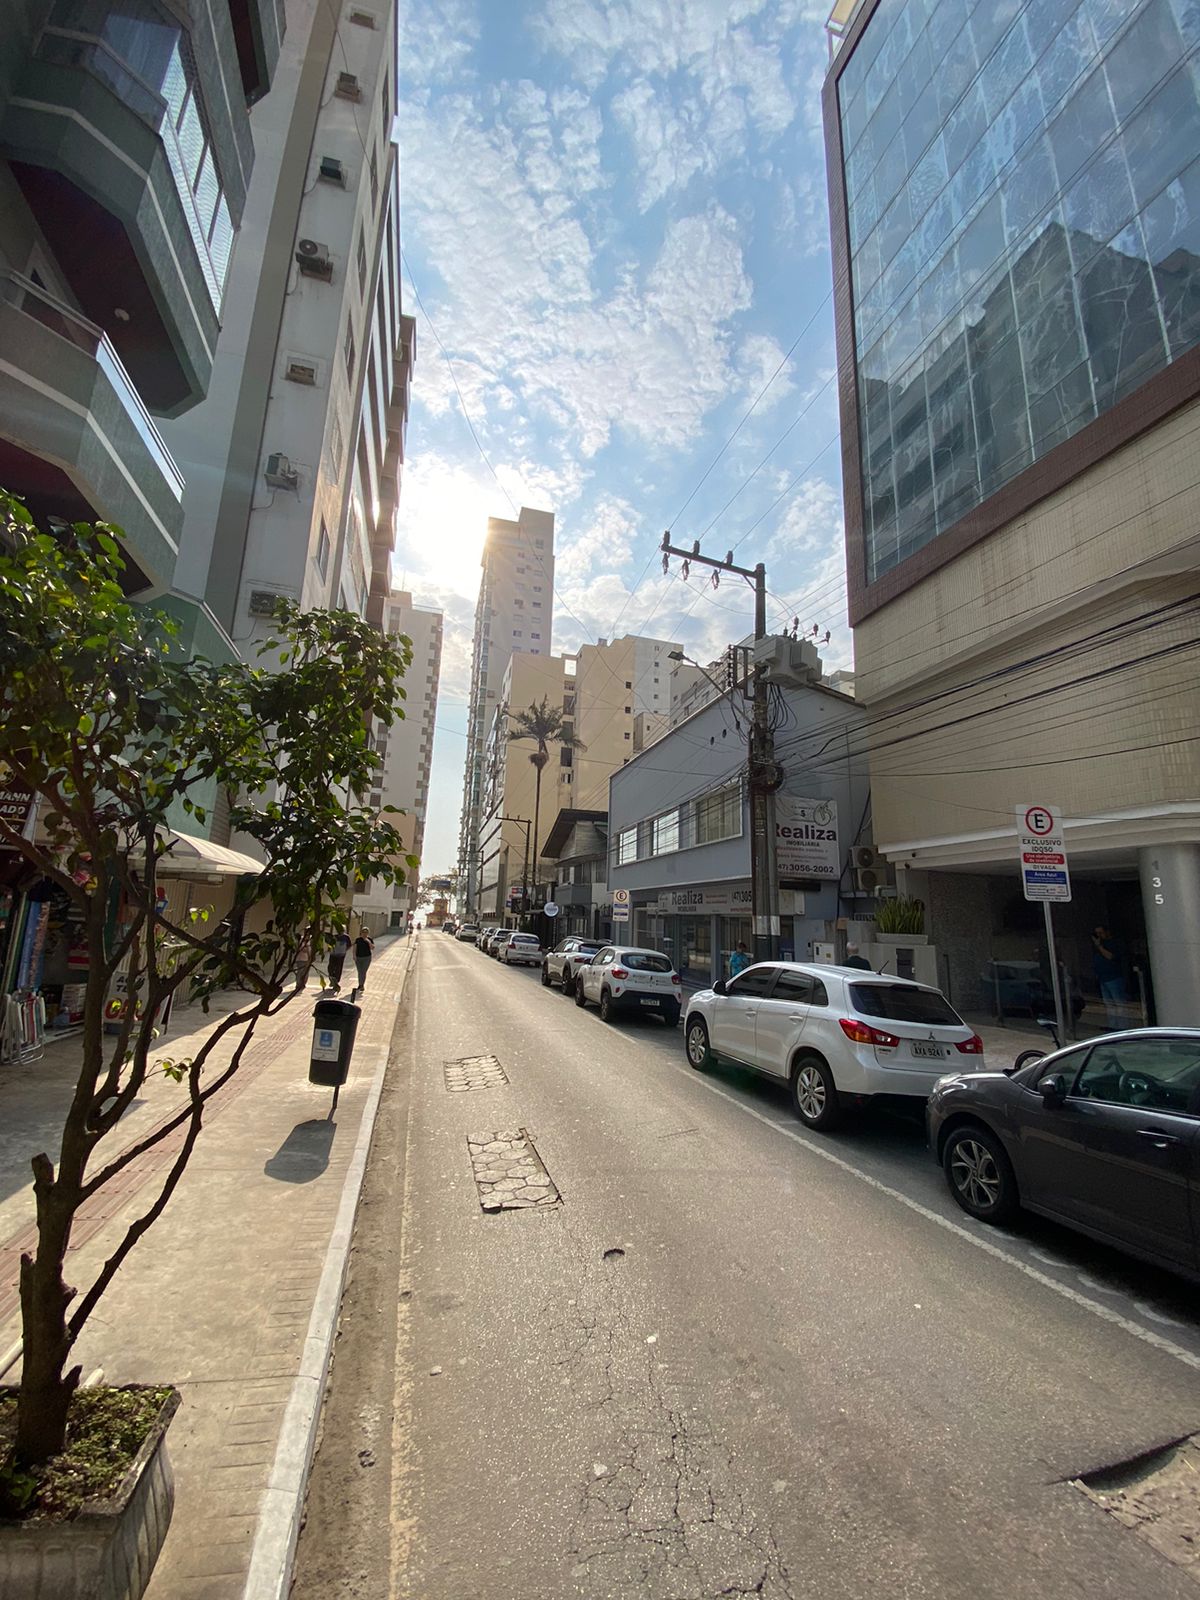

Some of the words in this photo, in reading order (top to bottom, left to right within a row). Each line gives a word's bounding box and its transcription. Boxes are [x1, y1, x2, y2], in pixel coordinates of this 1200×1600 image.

[1034, 813, 1045, 829] E
[1022, 838, 1062, 846] EXCLUSIVO
[671, 890, 704, 906] Realiza
